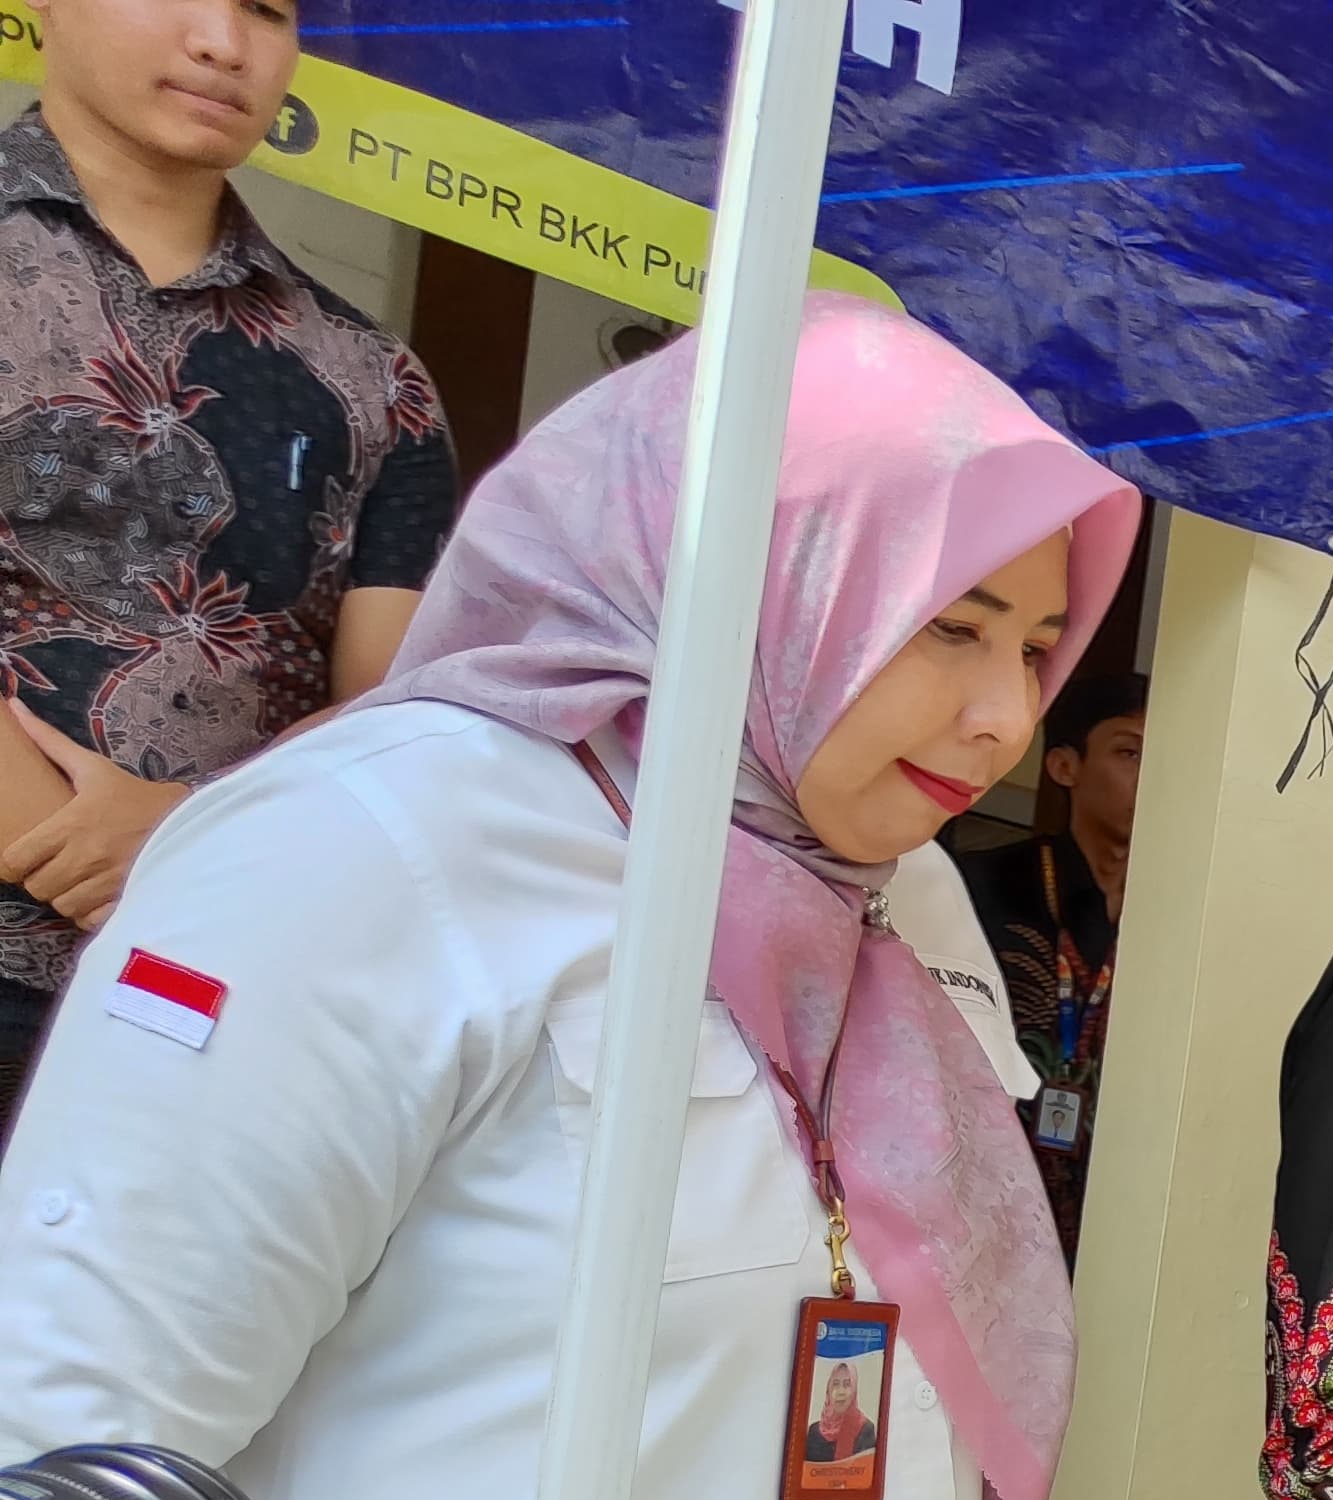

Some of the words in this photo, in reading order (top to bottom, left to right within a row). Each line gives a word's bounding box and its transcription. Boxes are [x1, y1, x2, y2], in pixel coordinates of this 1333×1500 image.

[349, 128, 412, 183] PT
[425, 159, 524, 229] BPR
[539, 203, 631, 270] BKK
